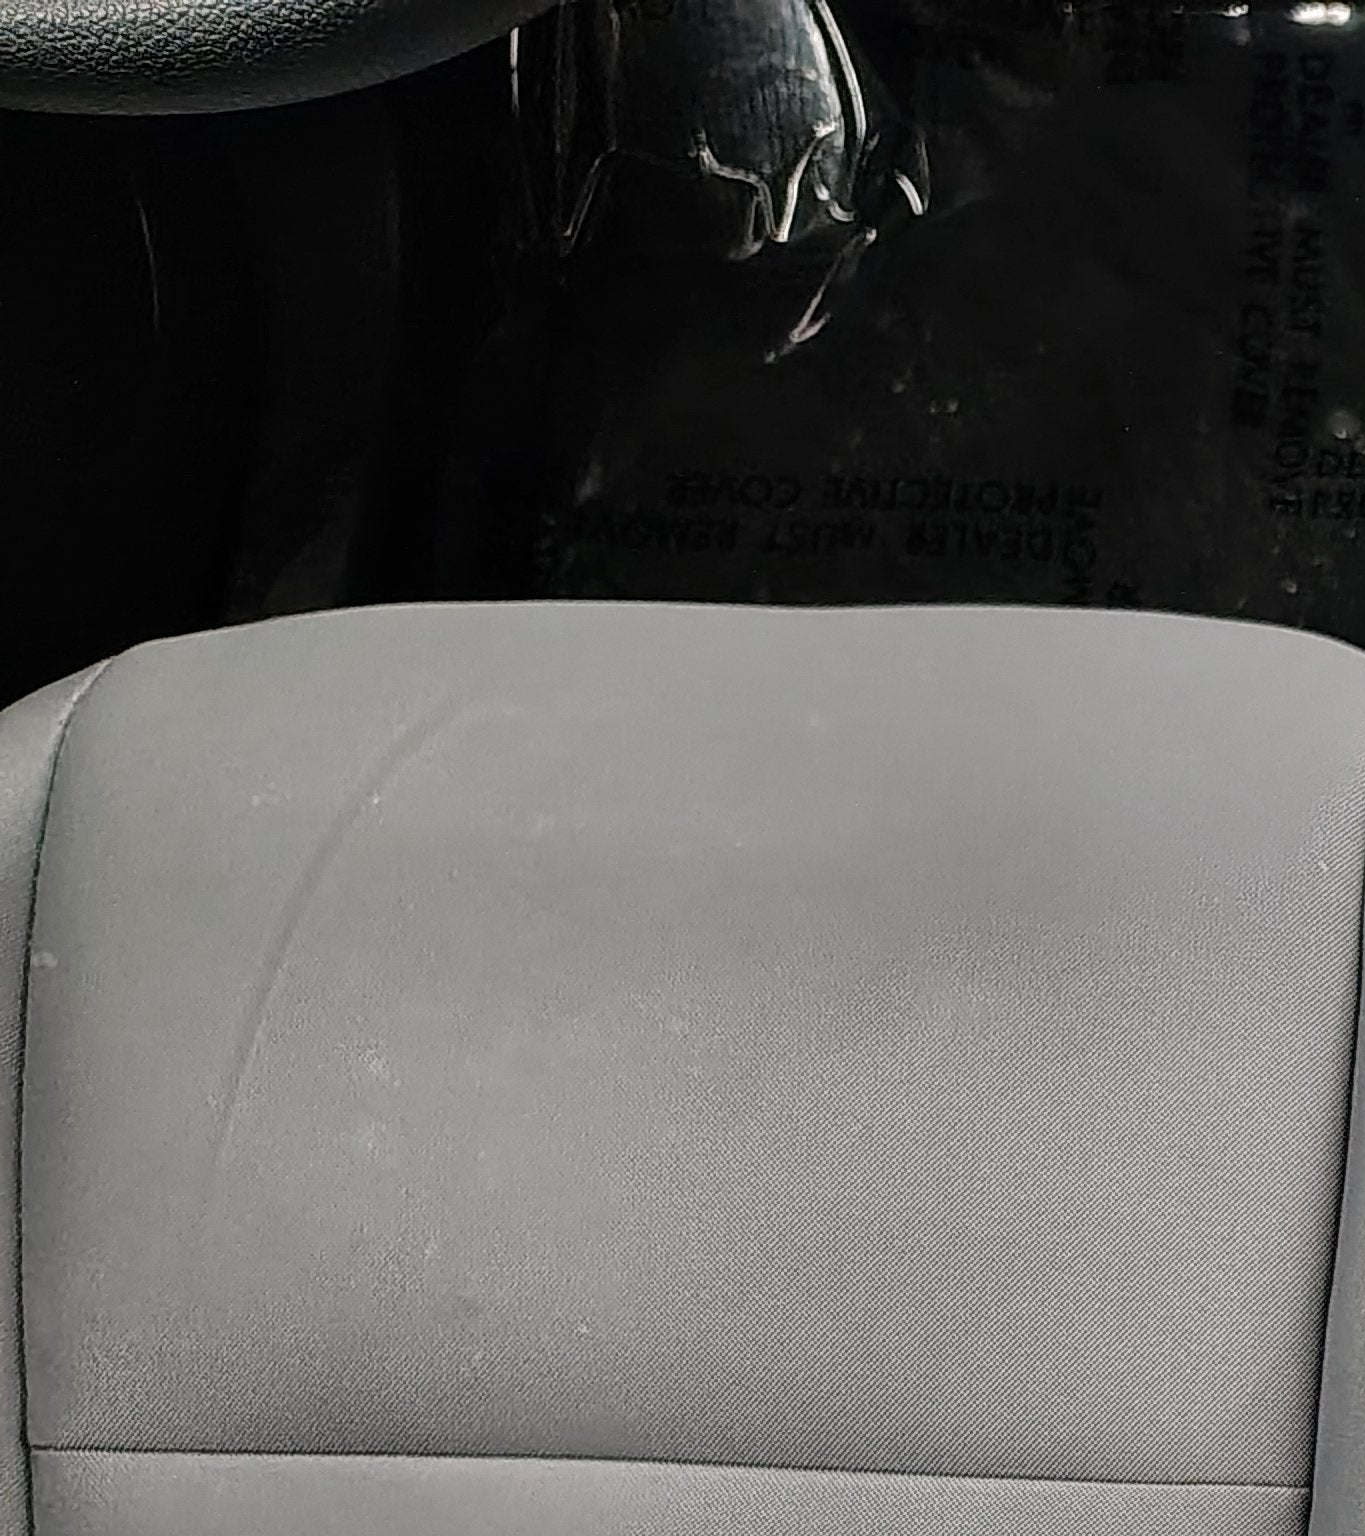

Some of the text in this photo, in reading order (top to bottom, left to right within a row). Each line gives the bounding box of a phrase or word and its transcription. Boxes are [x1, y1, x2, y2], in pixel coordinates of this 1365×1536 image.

[665, 472, 1058, 516] PROTECTIVE COVER
[760, 521, 877, 556] MUST
[905, 524, 1054, 563] DEALER
